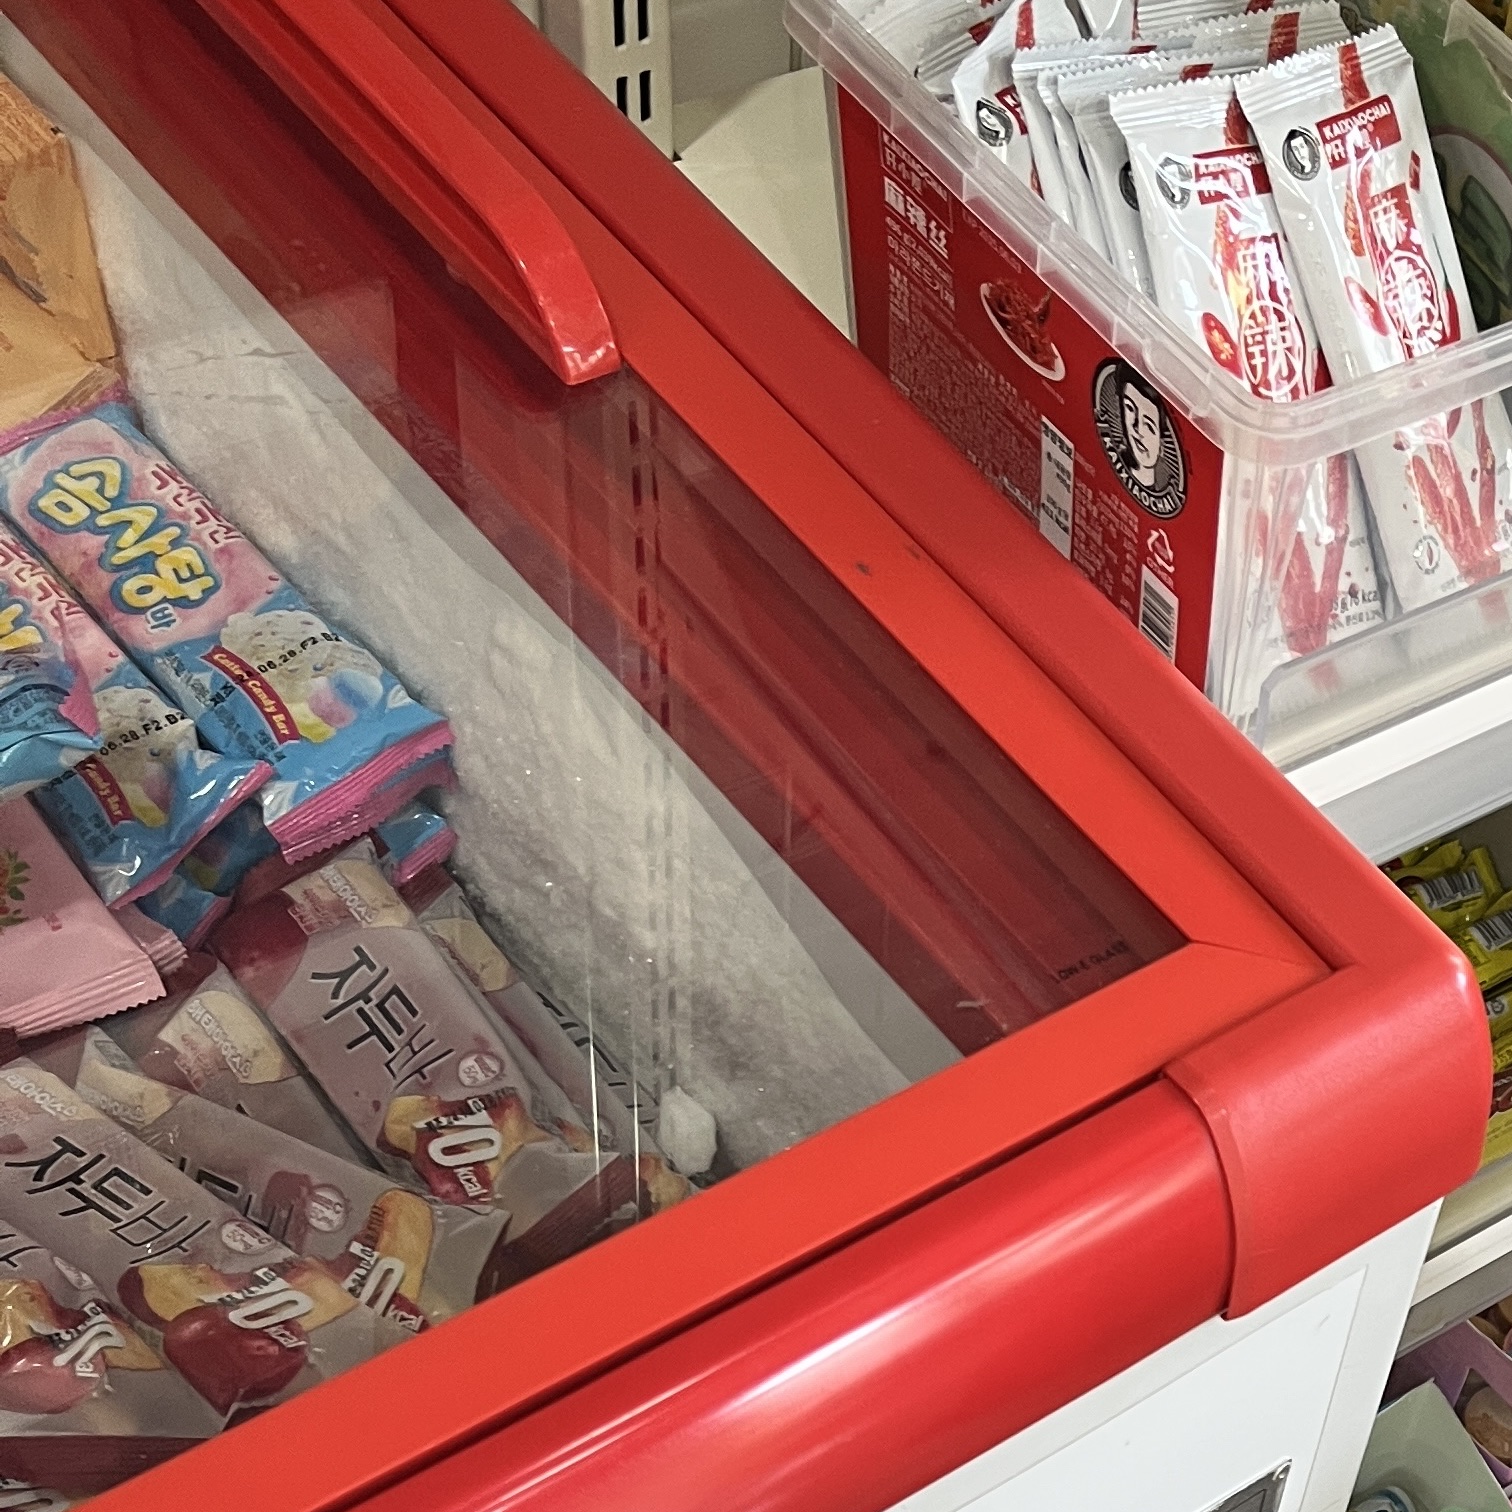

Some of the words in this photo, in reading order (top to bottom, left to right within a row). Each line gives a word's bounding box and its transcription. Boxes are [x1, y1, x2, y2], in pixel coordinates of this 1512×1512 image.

[36, 458, 216, 608] 솜사탕
[309, 944, 456, 1094] 자두바
[4, 1134, 212, 1266] 자두바
